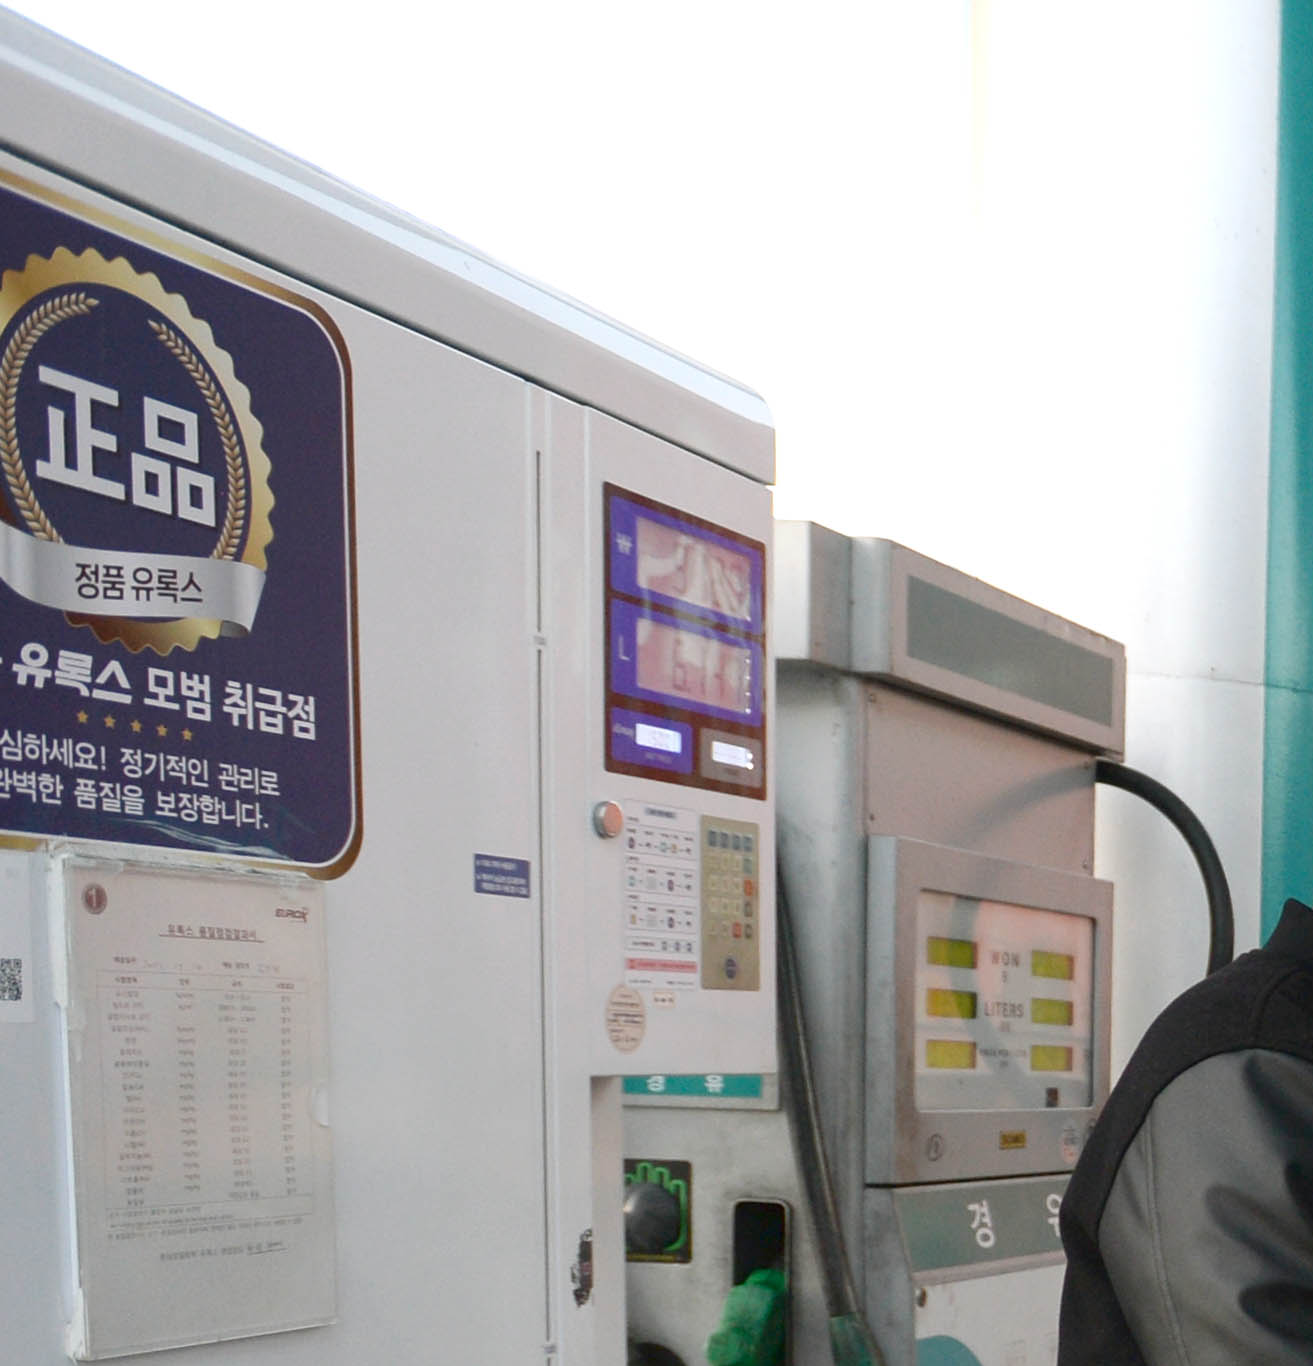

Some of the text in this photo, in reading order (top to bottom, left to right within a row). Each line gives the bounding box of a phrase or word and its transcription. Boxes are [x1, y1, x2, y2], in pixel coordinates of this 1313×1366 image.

[36, 364, 217, 528] 正品
[74, 562, 204, 604] 정품 유록스
[12, 642, 317, 741] 유록스 모범 취급점
[120, 747, 209, 788] 정기적인
[218, 762, 281, 797] 관리로
[74, 778, 145, 817] 품질을
[155, 791, 270, 830] 보장합니다.
[984, 1001, 1024, 1019] LITERS
